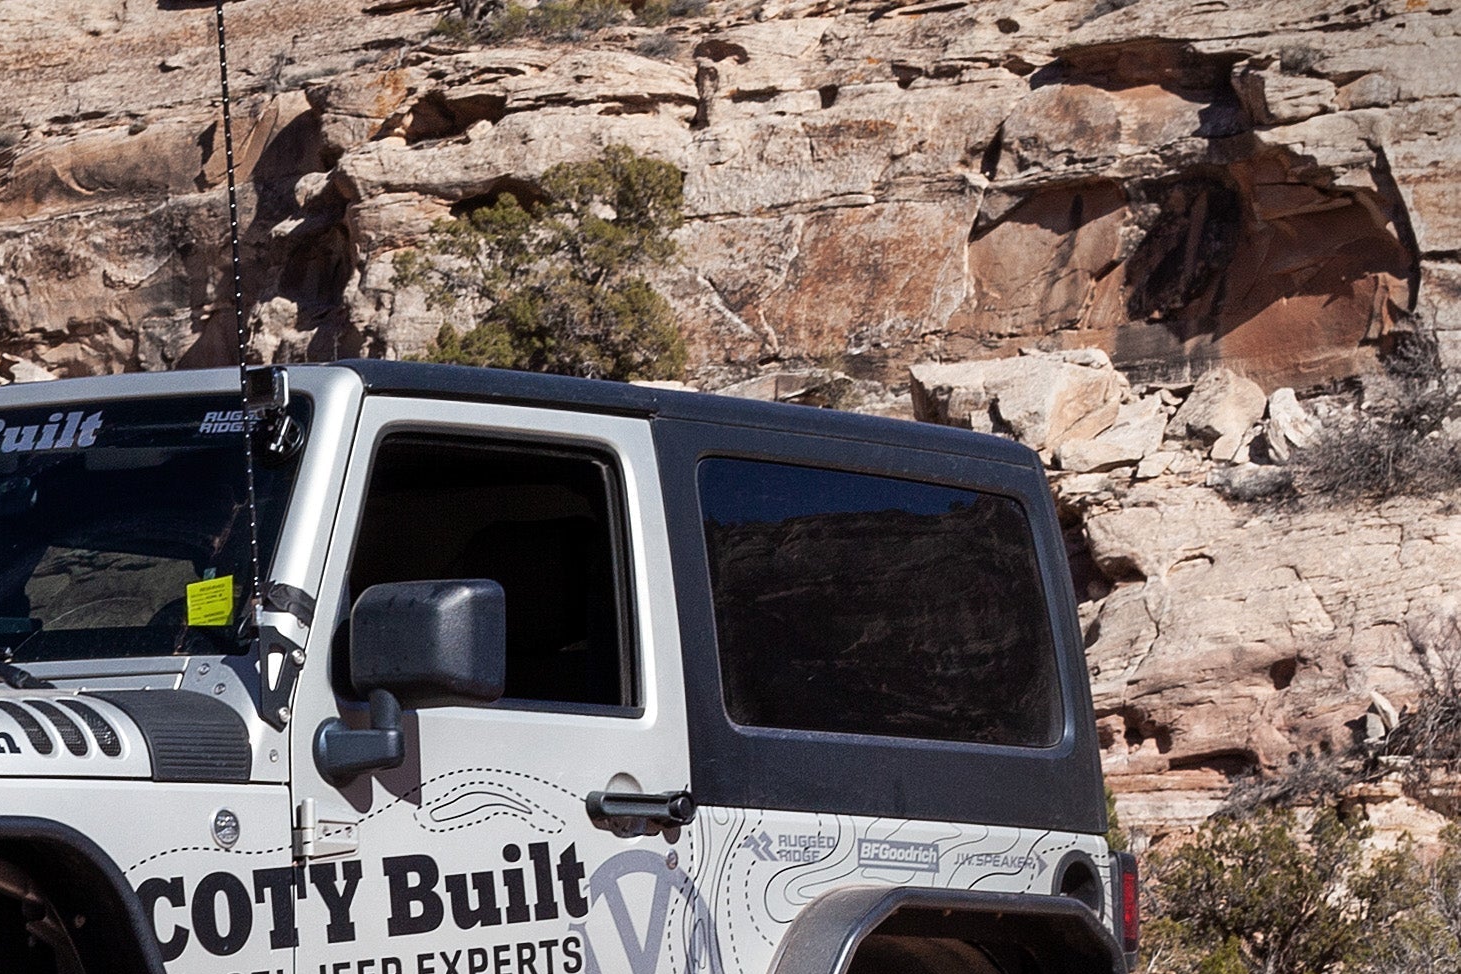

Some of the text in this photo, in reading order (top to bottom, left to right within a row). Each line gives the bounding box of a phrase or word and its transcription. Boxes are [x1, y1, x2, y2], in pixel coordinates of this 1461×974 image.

[778, 834, 836, 849] RUGGED
[778, 850, 820, 862] RIDGE
[860, 841, 938, 864] BFGoodrich
[134, 842, 589, 962] COTY Built
